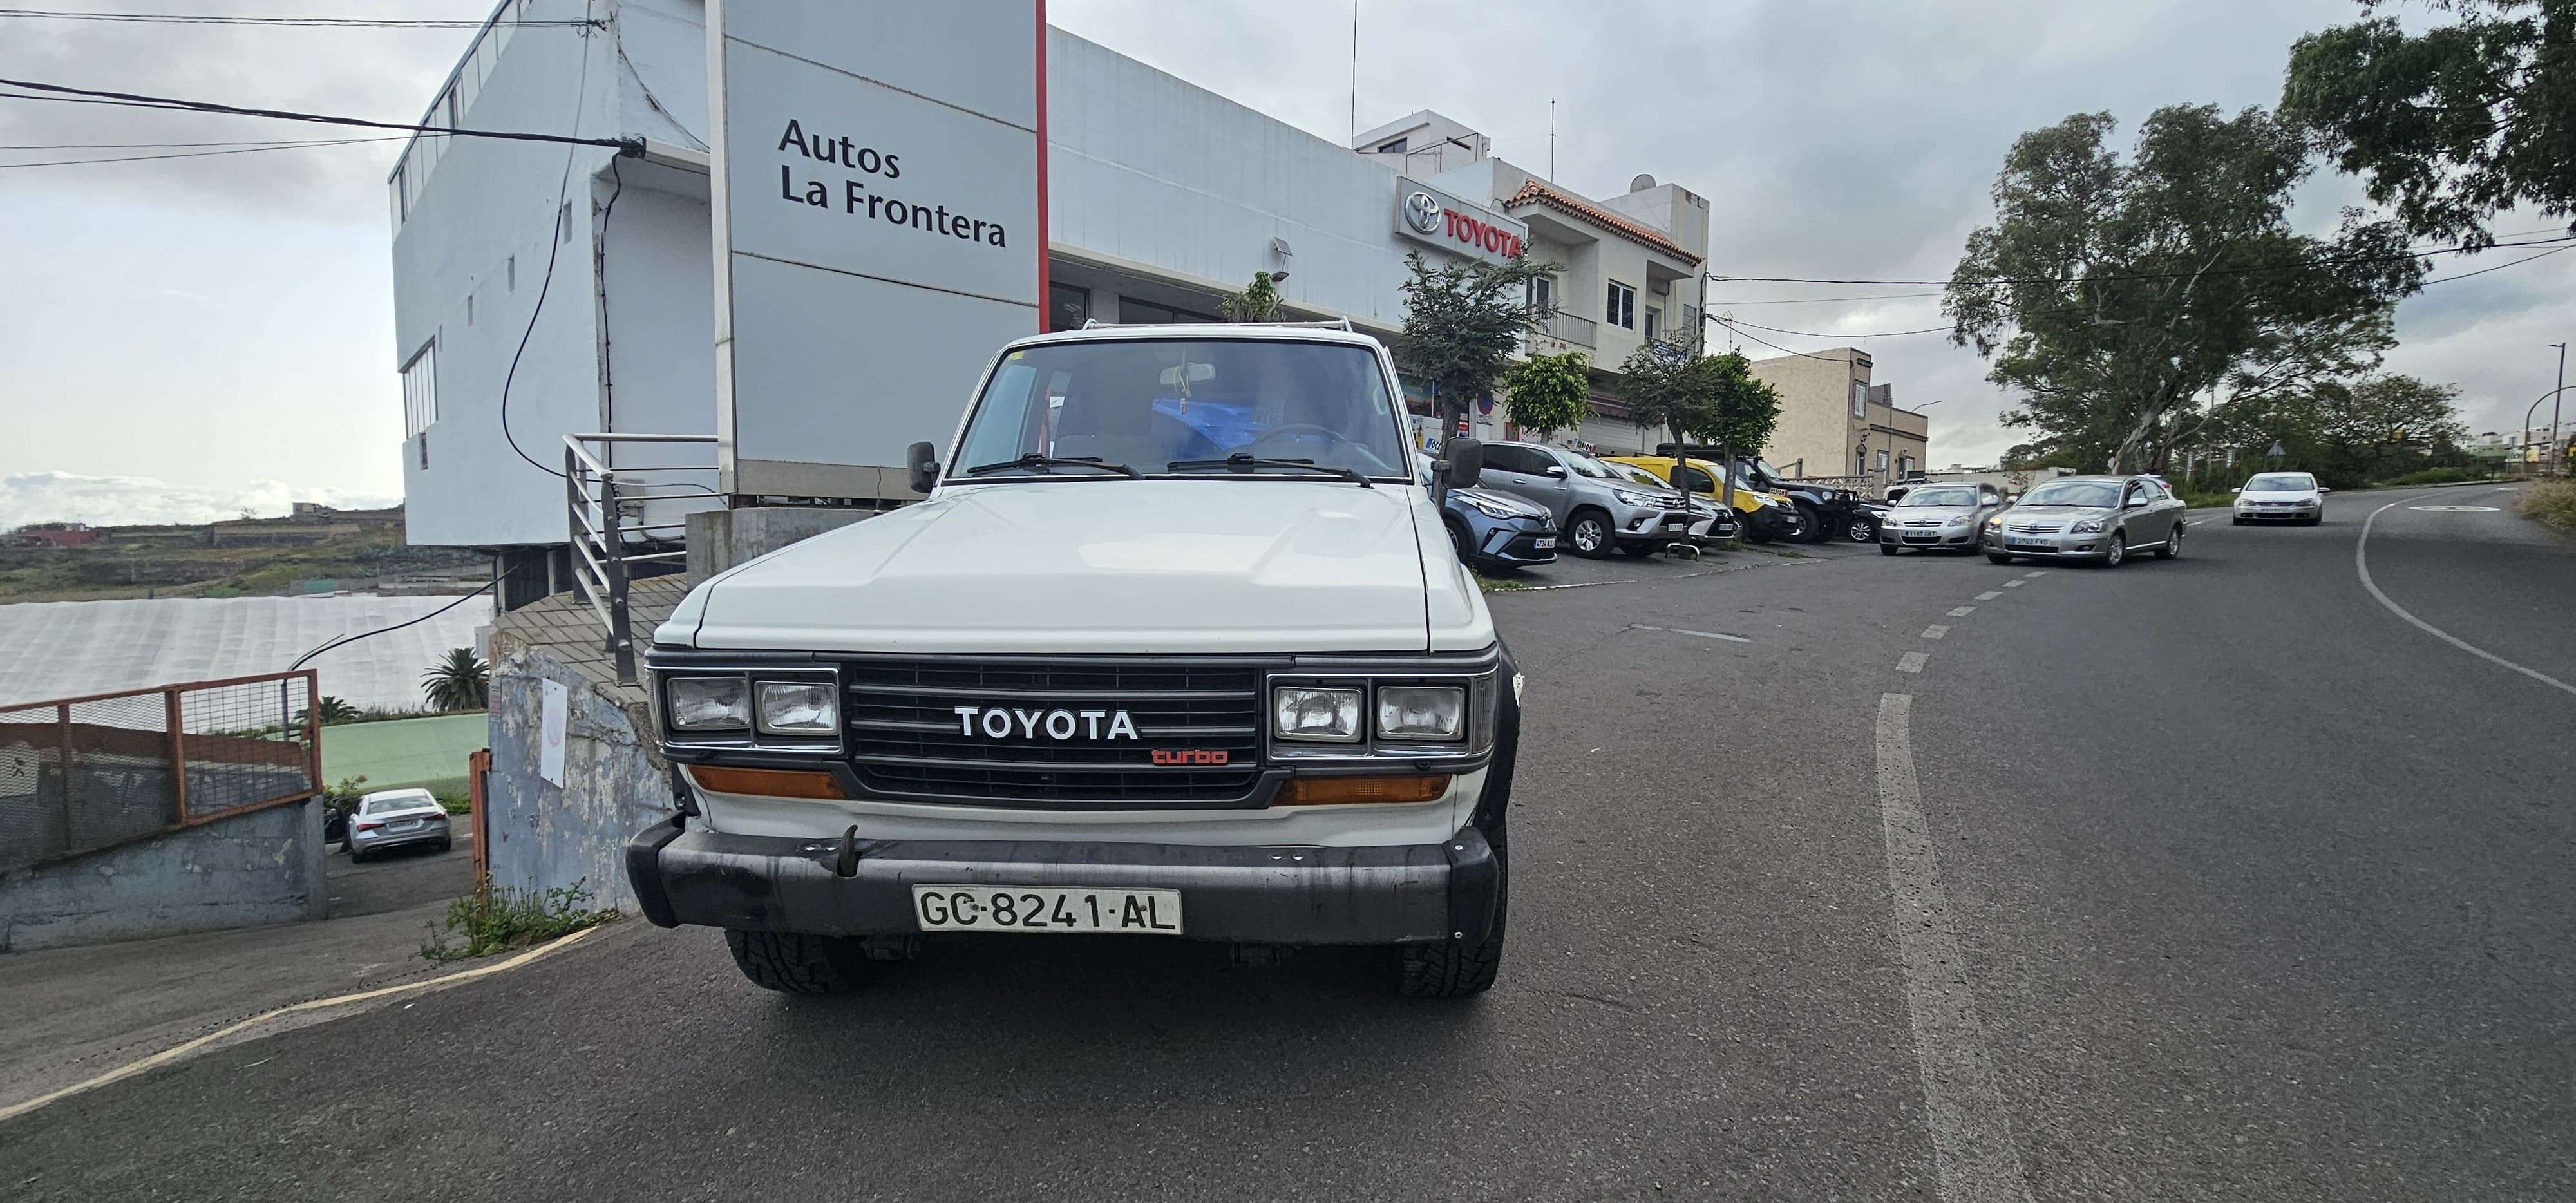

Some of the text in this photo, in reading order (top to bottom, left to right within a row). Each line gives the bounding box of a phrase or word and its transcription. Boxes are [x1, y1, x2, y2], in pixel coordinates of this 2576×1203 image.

[777, 118, 900, 179] Autos
[782, 165, 1006, 248] La Frontera
[1444, 208, 1522, 258] TOYOTA
[954, 706, 1139, 740] TOYOTA
[1151, 748, 1228, 765] turbo
